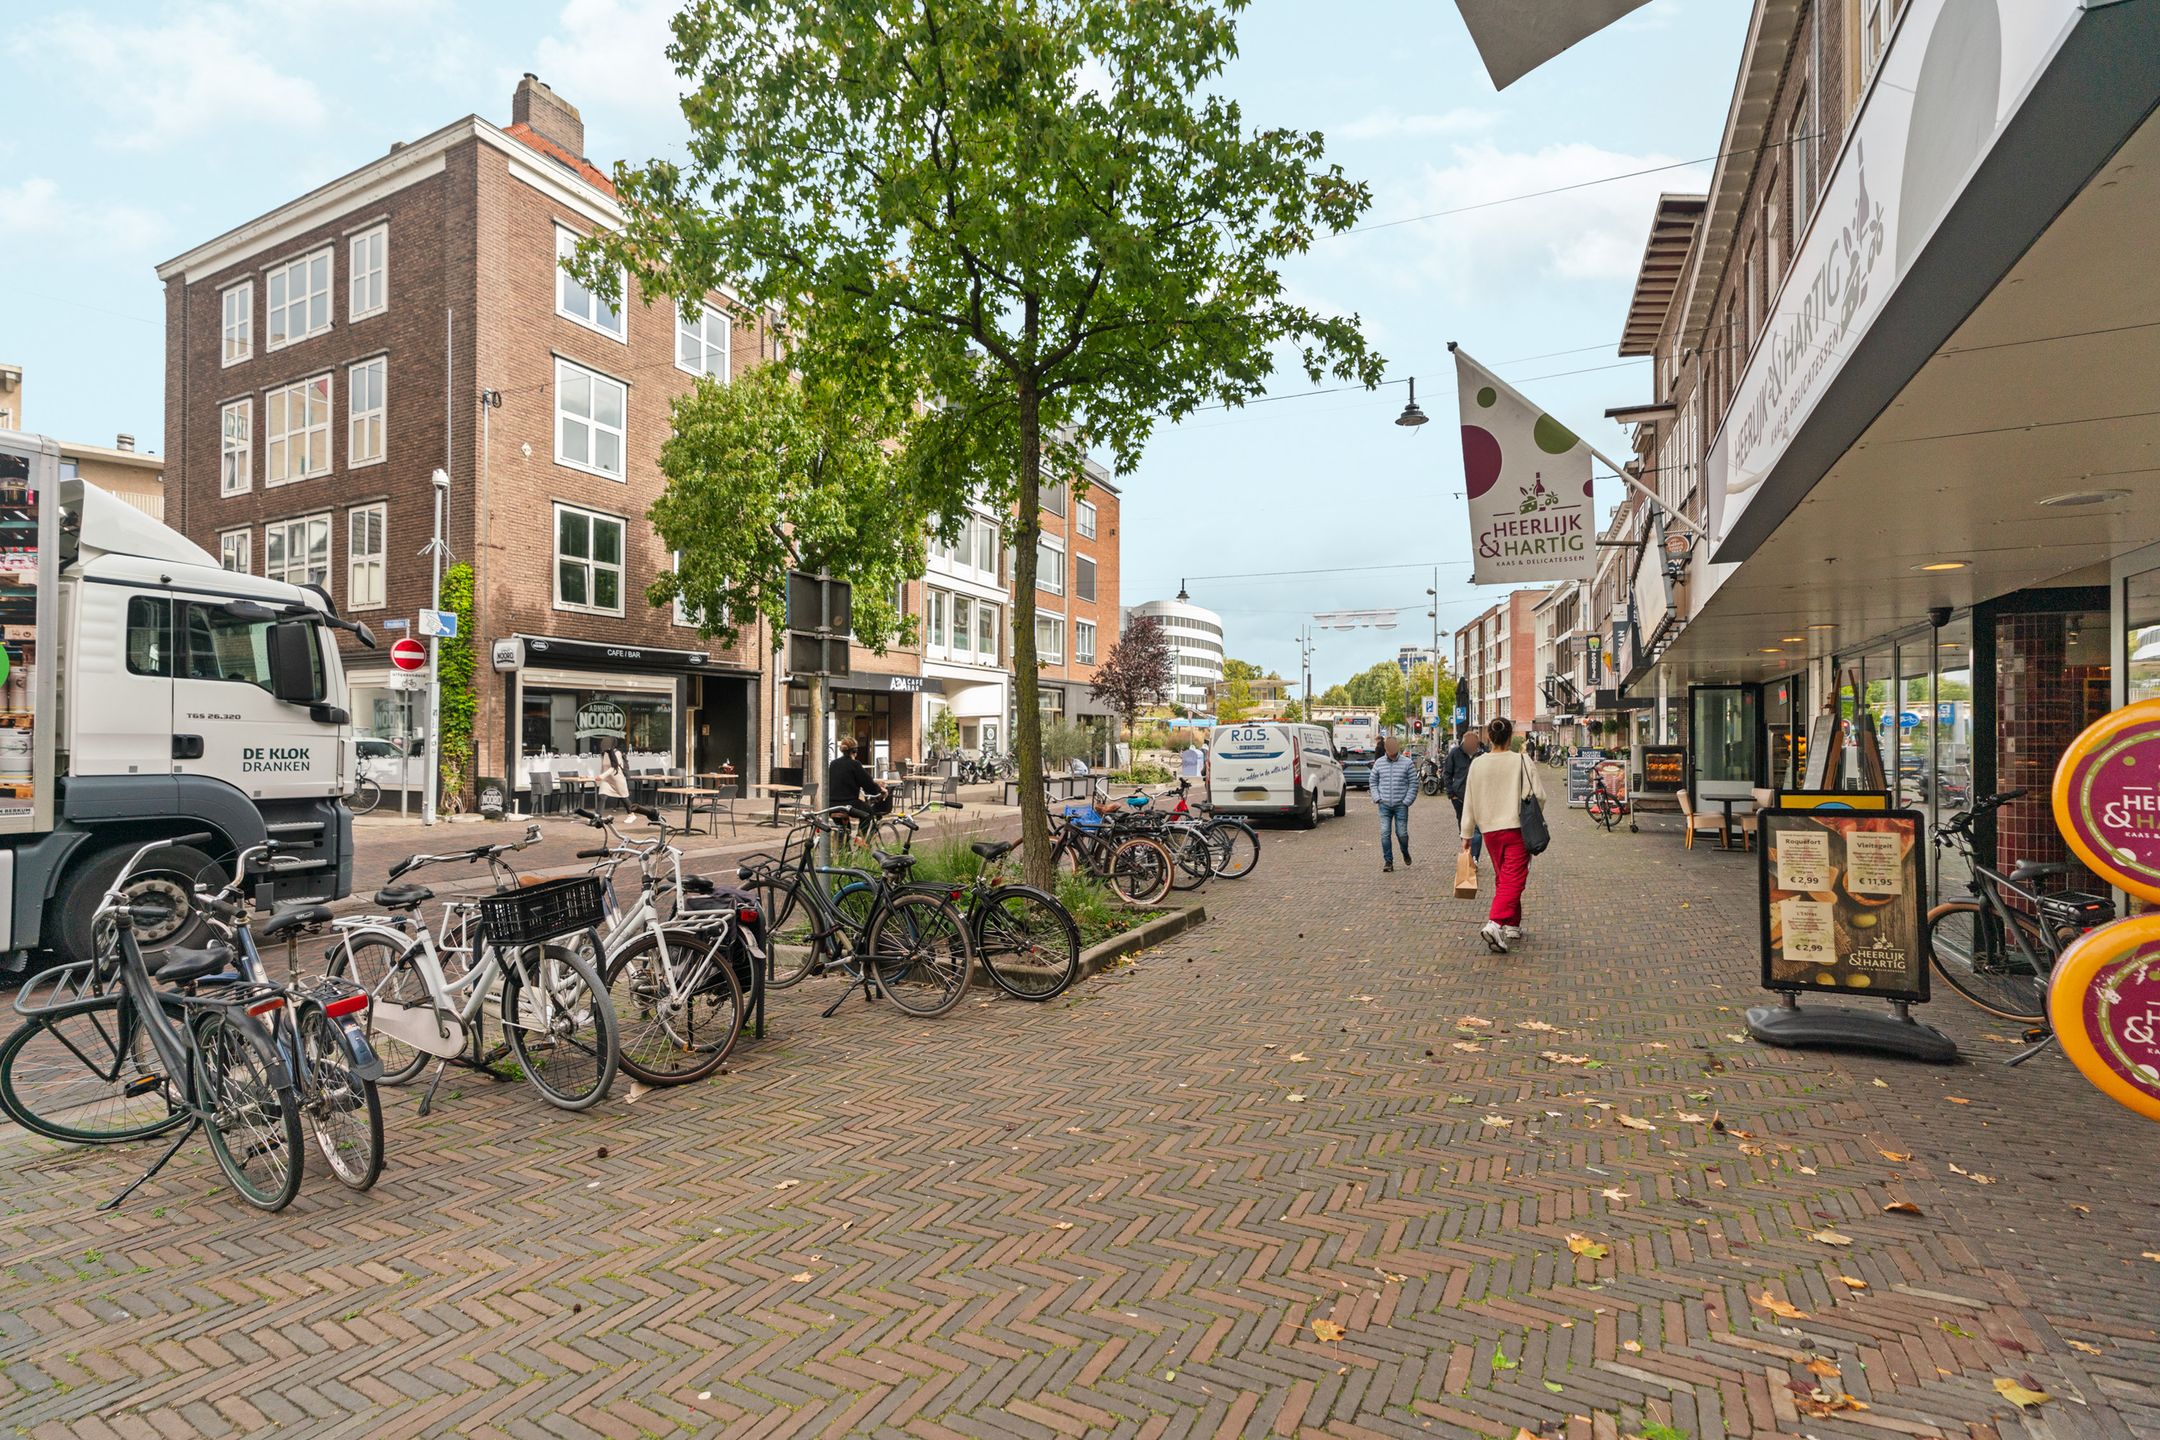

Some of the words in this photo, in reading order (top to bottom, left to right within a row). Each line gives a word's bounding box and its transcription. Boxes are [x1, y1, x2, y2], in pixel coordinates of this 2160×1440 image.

[1768, 330, 1782, 408] &
[1784, 238, 1839, 386] HARTIG
[1790, 323, 1839, 415] DELICATESSEN
[1735, 378, 1768, 476] HEERLIJK
[1493, 513, 1582, 538] HEERLIJK
[1479, 531, 1501, 558] &
[1504, 535, 1584, 557] HARTIG
[1526, 555, 1585, 565] DELICATESSEN
[607, 649, 623, 657] CAFE
[589, 704, 614, 713] ARNHEM
[580, 712, 624, 730] NOORD
[1231, 729, 1270, 741] R.O.S.
[243, 748, 264, 759] DE
[269, 748, 310, 759] KLOK
[242, 761, 310, 773] DRANKEN
[2123, 795, 2160, 811] HE
[2103, 802, 2134, 828] &
[2137, 814, 2160, 829] H
[1798, 876, 1819, 885] 2,99
[1849, 953, 1861, 966] &
[1863, 960, 1905, 969] HARTIG
[1857, 951, 1904, 961] HEERLIJK
[2124, 1016, 2157, 1045] &
